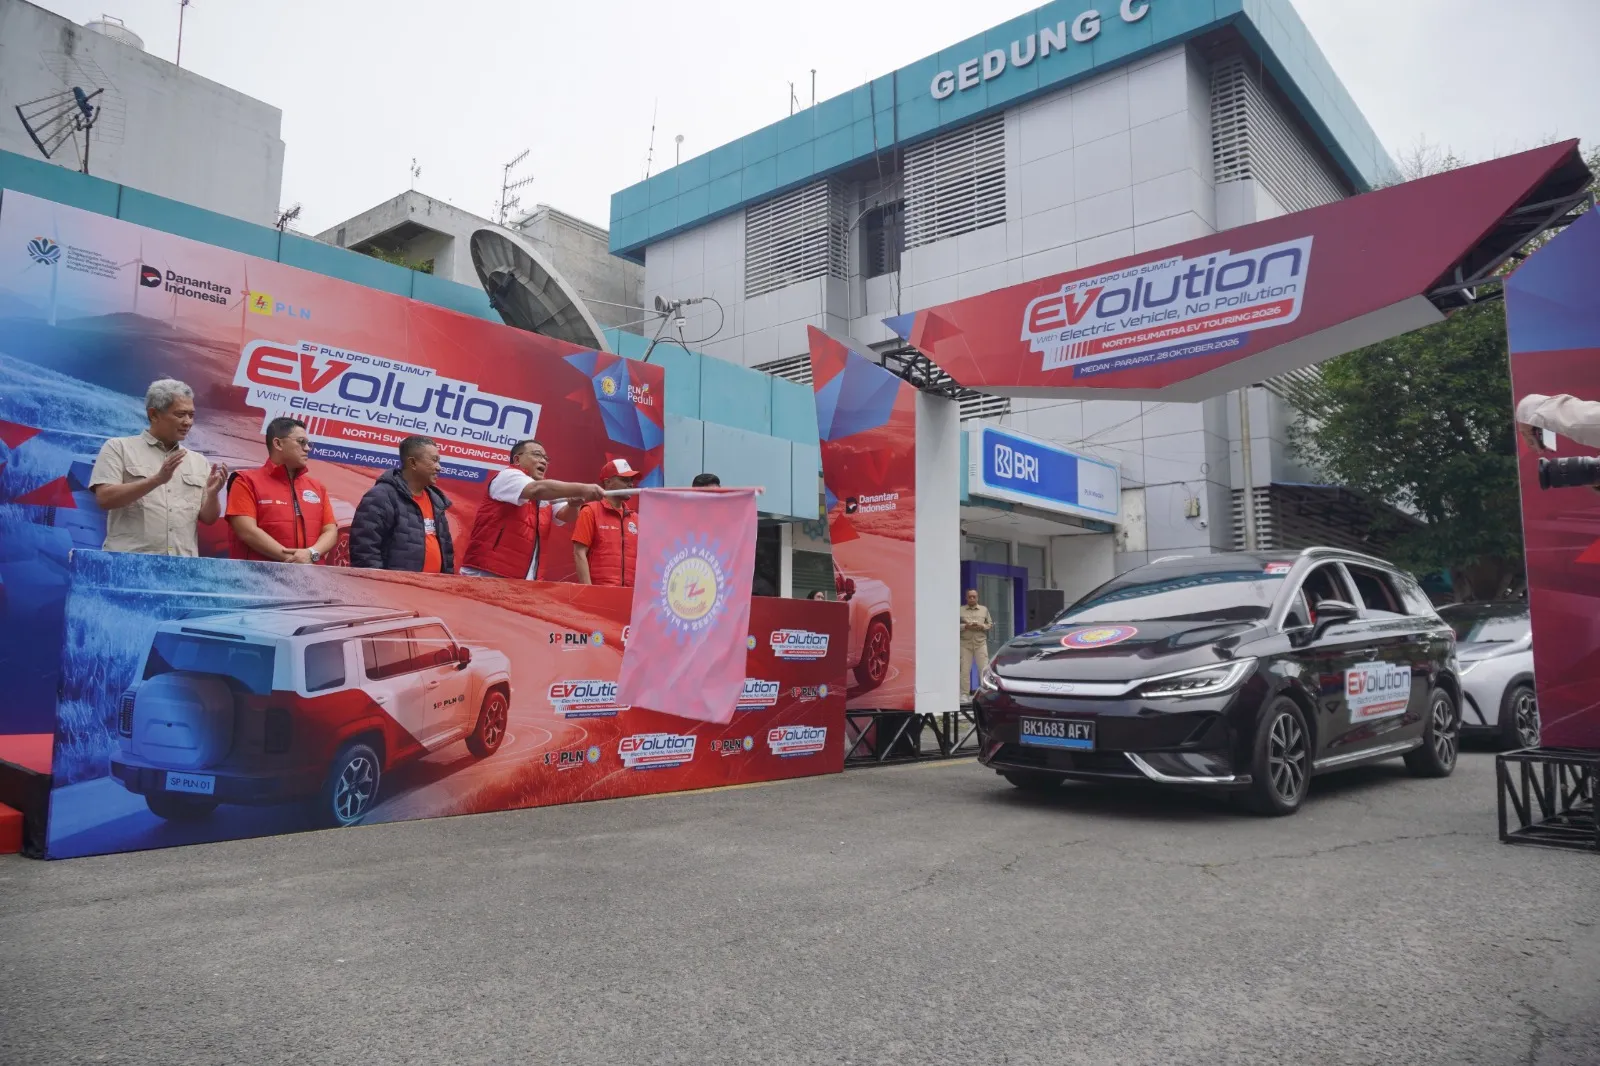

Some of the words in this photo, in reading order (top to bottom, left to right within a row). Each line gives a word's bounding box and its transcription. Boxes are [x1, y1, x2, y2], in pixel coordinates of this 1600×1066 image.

[930, 9, 1101, 100] GEDUNG
[1119, 0, 1150, 23] C
[165, 269, 232, 295] Danantara
[1064, 284, 1078, 292] SP
[1079, 278, 1099, 289] PLN
[1100, 273, 1120, 284] DPD
[1121, 269, 1139, 279] UID
[1140, 259, 1179, 274] SUMUT
[164, 282, 227, 305] Indonesia
[1028, 247, 1303, 334] EVolution
[275, 302, 311, 320] PLN
[1036, 333, 1058, 345] With
[1060, 322, 1116, 342] Electric
[1119, 309, 1181, 329] Vehicle,
[1185, 301, 1210, 316] No
[1214, 283, 1297, 309] Pollution
[1101, 336, 1137, 349] NORTH
[1136, 326, 1186, 343] SUMATRA
[1187, 323, 1202, 333] EV
[1203, 312, 1251, 329] TOURING
[301, 343, 318, 352] SP
[320, 347, 344, 359] PLN
[346, 353, 370, 364] DPD
[372, 359, 391, 369] UID
[393, 363, 433, 377] SUMUT
[1080, 361, 1111, 374] MEDAN
[1114, 354, 1156, 369] PARAPAT,
[1157, 350, 1169, 360] 28
[1169, 342, 1214, 358] OKTOBER
[246, 346, 534, 435] EVolution
[627, 384, 641, 394] PLN
[627, 390, 653, 406] Peduli
[256, 389, 287, 402] With
[289, 396, 361, 419] Electric
[366, 408, 429, 433] Vehicle,
[434, 421, 457, 436] No
[461, 427, 520, 447] Pollutio
[342, 427, 382, 441] NORTH
[313, 447, 349, 460] MEDAN
[355, 453, 400, 468] PARAPAT,
[449, 445, 490, 459] TOURING
[458, 470, 480, 479] 2026
[1014, 451, 1039, 484] BRI
[859, 492, 899, 504] Danantara
[859, 501, 897, 513] Indonesia
[549, 632, 562, 644] SP
[564, 633, 588, 644] PLN
[791, 686, 800, 698] SP
[802, 686, 817, 697] PLN
[433, 701, 442, 709] SP
[444, 697, 457, 706] PLN
[1068, 723, 1090, 740] AFY
[620, 735, 695, 753] EVolution
[711, 739, 722, 751] SP
[723, 738, 741, 750] PLN
[544, 751, 558, 765] SP
[560, 750, 584, 763] PLN
[170, 777, 181, 786] SP
[182, 778, 199, 788] PLN
[200, 780, 210, 790] 01
